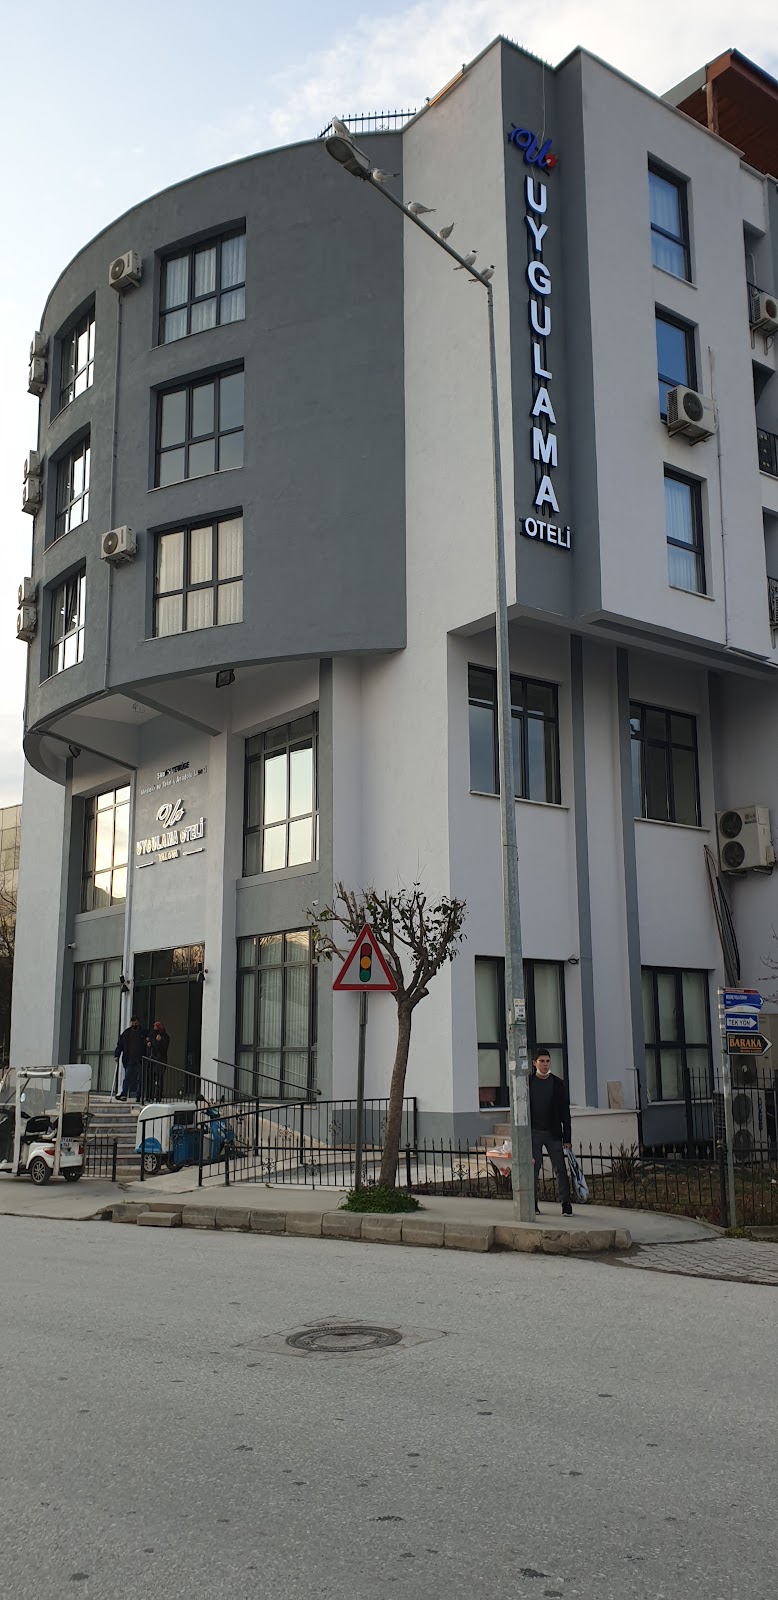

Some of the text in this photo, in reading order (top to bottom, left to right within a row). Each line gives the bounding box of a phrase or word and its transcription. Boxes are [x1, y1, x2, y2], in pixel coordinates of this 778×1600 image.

[525, 175, 560, 514] UYGULAMA
[523, 517, 571, 549] OTELİ
[136, 817, 204, 856] UYGULAMA OTELİ
[730, 1038, 762, 1047] BARAKA
